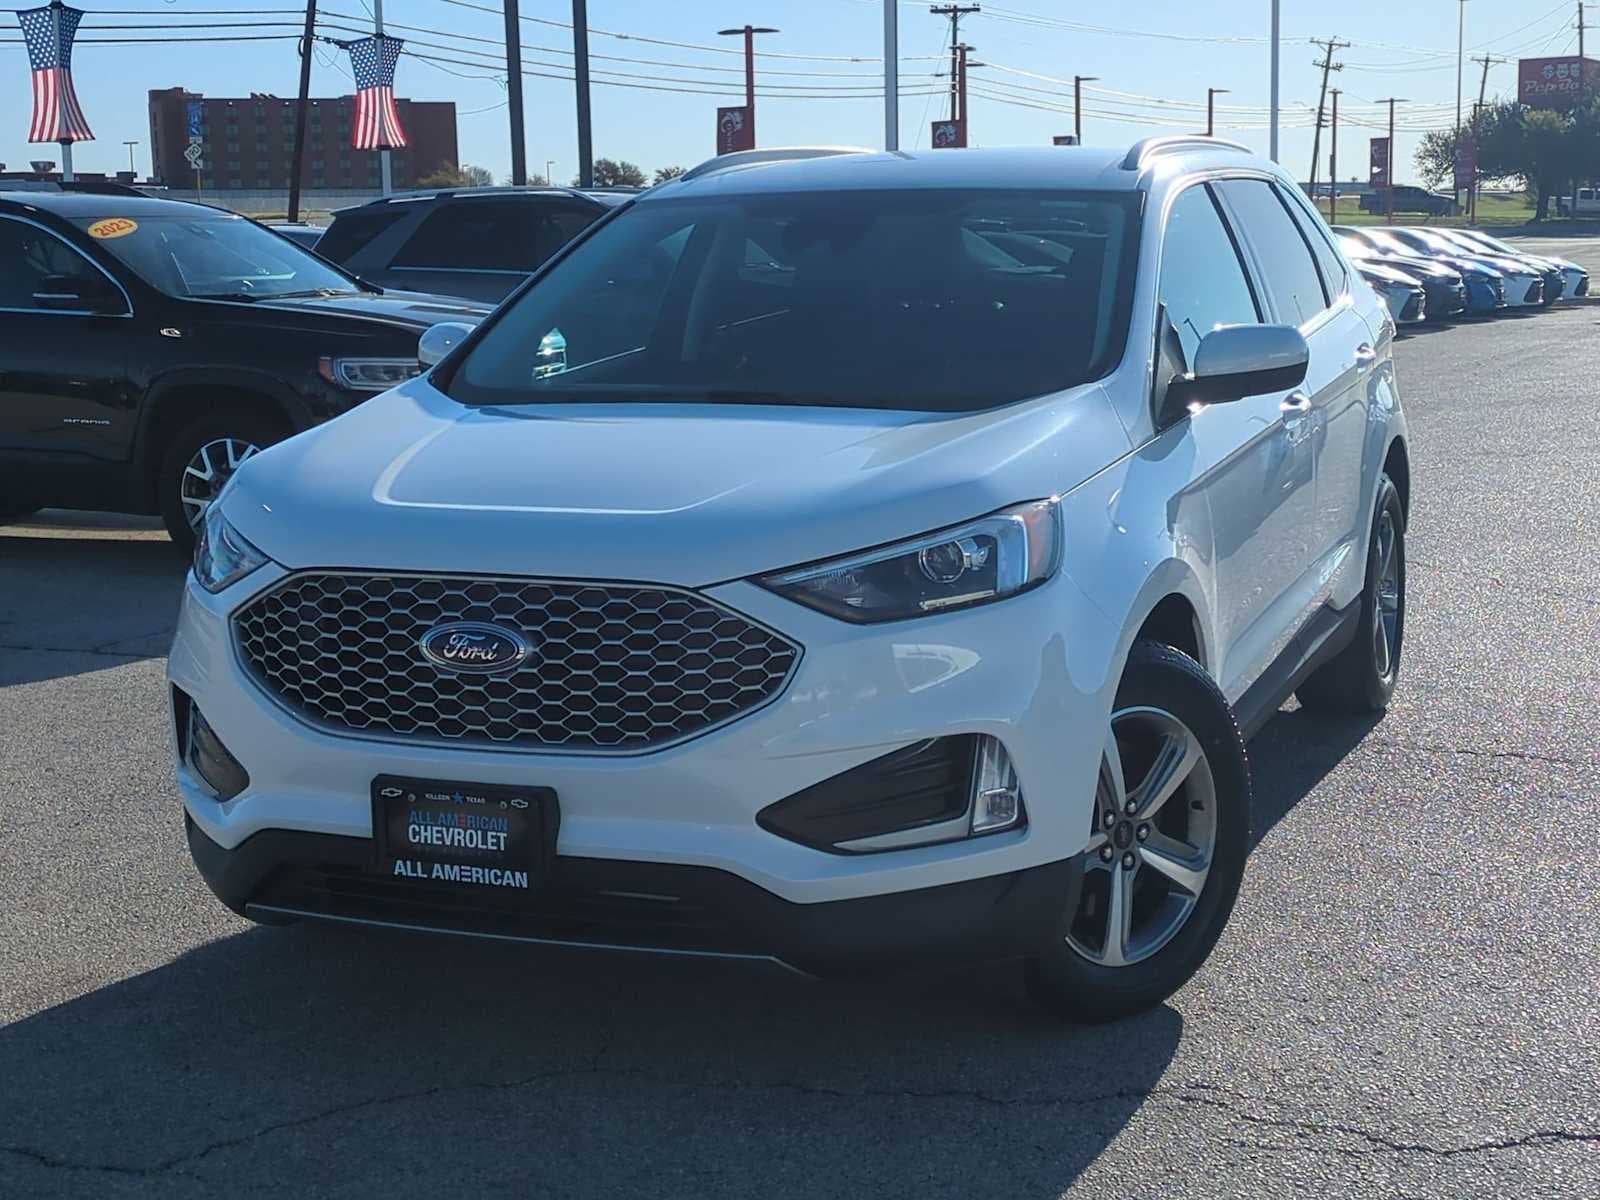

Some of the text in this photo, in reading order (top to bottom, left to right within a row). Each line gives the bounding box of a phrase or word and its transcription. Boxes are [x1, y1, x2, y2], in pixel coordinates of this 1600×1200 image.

[94, 219, 134, 237] 2023
[443, 633, 499, 660] Ford
[409, 810, 508, 831] ALL AMERICAN
[408, 825, 507, 851] CHEVROLET
[394, 859, 528, 889] ALL AMERICAN
